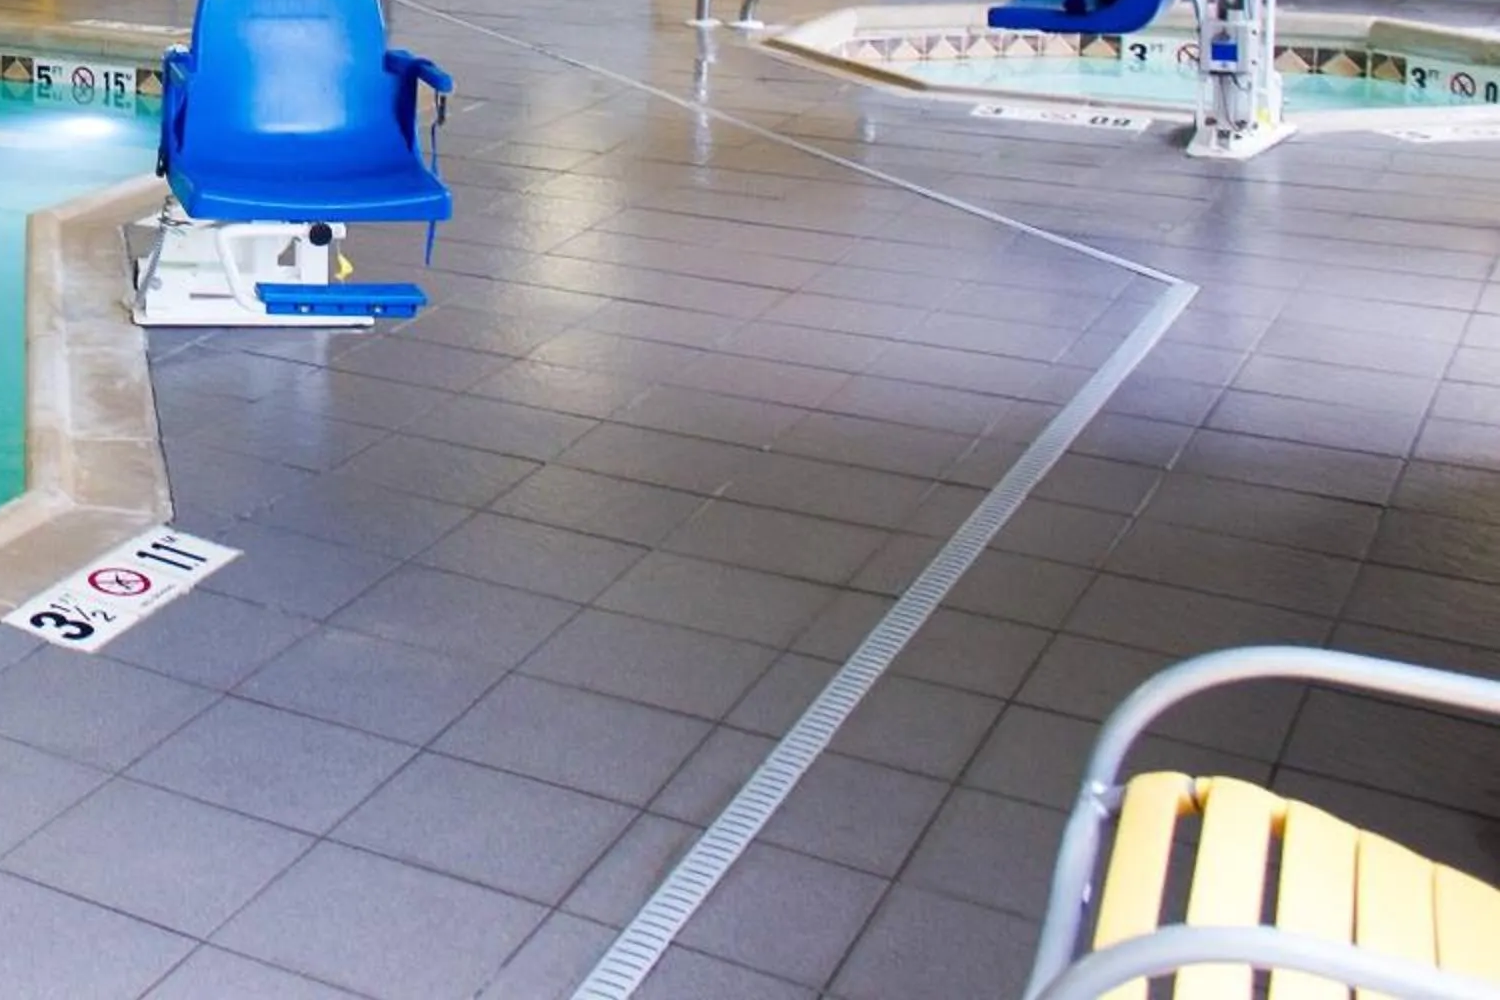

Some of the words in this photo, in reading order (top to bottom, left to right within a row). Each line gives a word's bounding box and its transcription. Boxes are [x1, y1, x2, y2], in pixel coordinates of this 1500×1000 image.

[37, 65, 52, 89] 5
[103, 71, 125, 94] 15
[135, 542, 208, 571] 11
